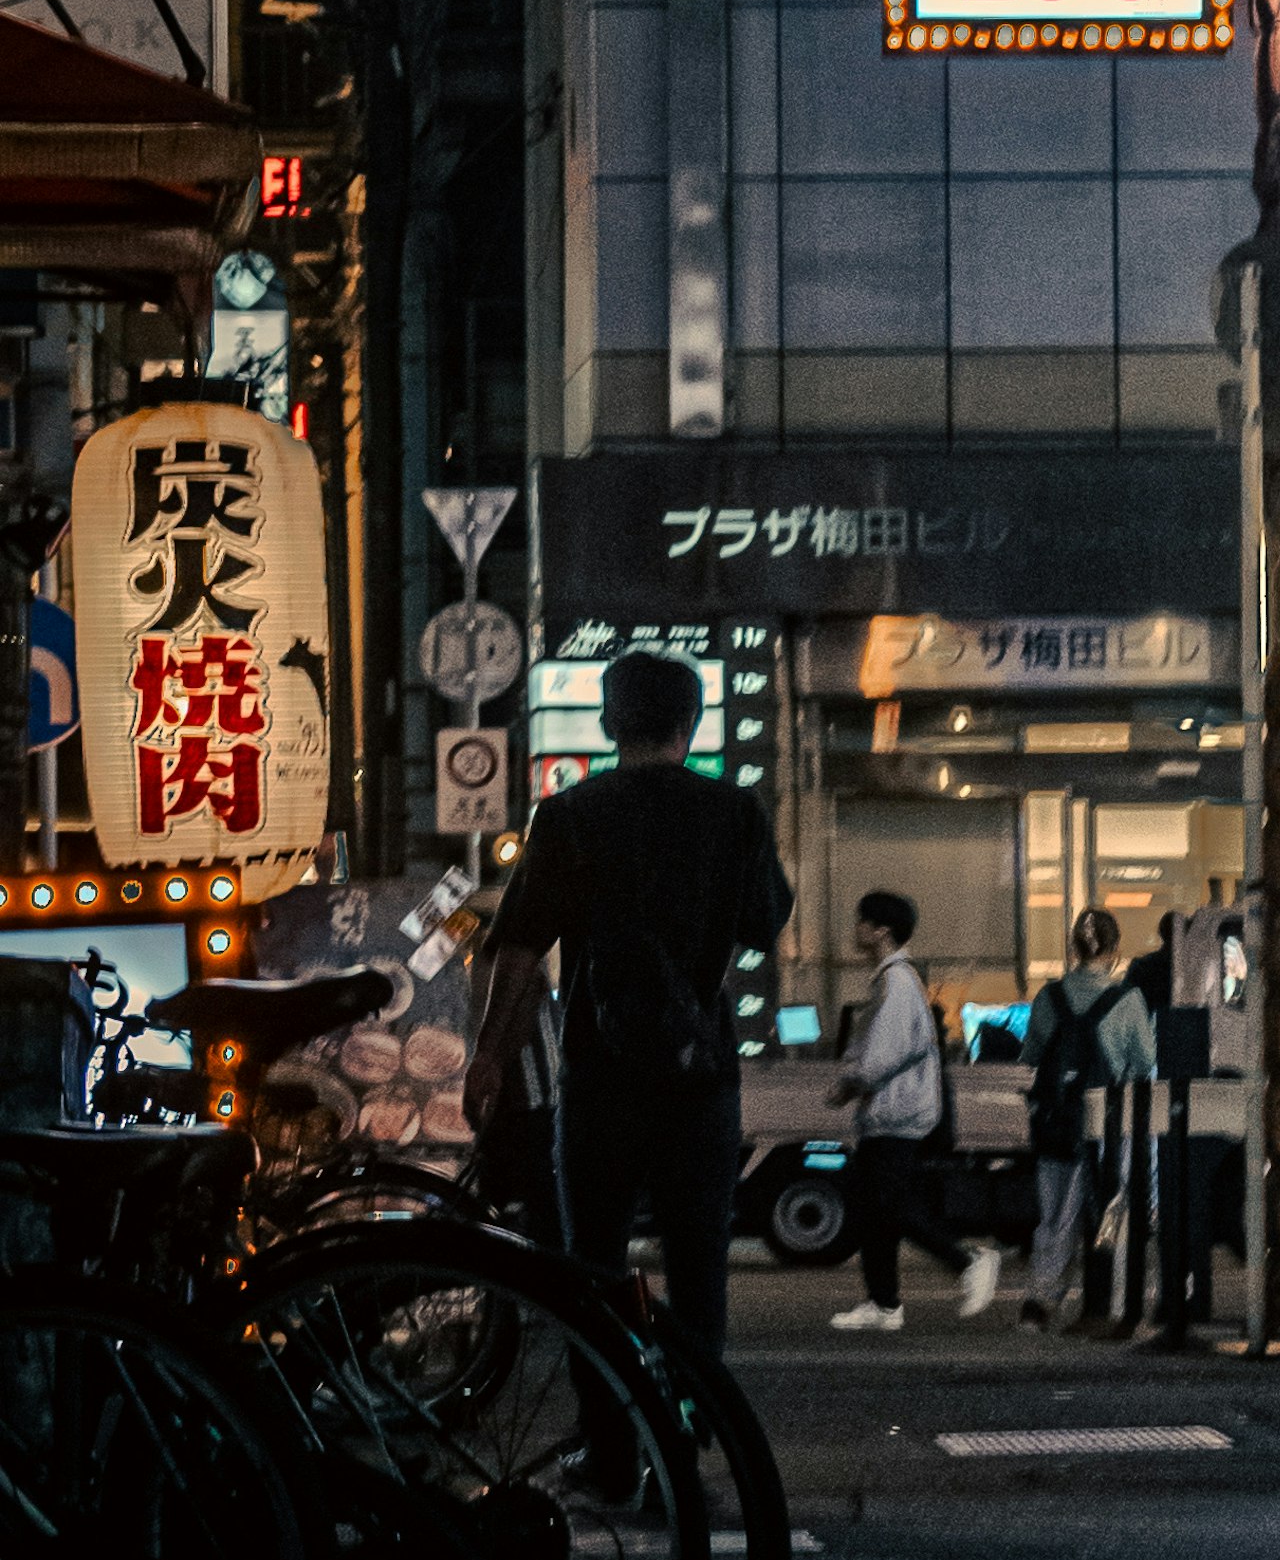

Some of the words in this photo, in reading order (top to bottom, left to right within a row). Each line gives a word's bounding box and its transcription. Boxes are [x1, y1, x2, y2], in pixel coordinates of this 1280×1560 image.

[662, 505, 1012, 560] プラザ梅田ビル
[124, 442, 266, 835] 炭火焼肉
[888, 622, 1202, 673] プラザ梅田ビル
